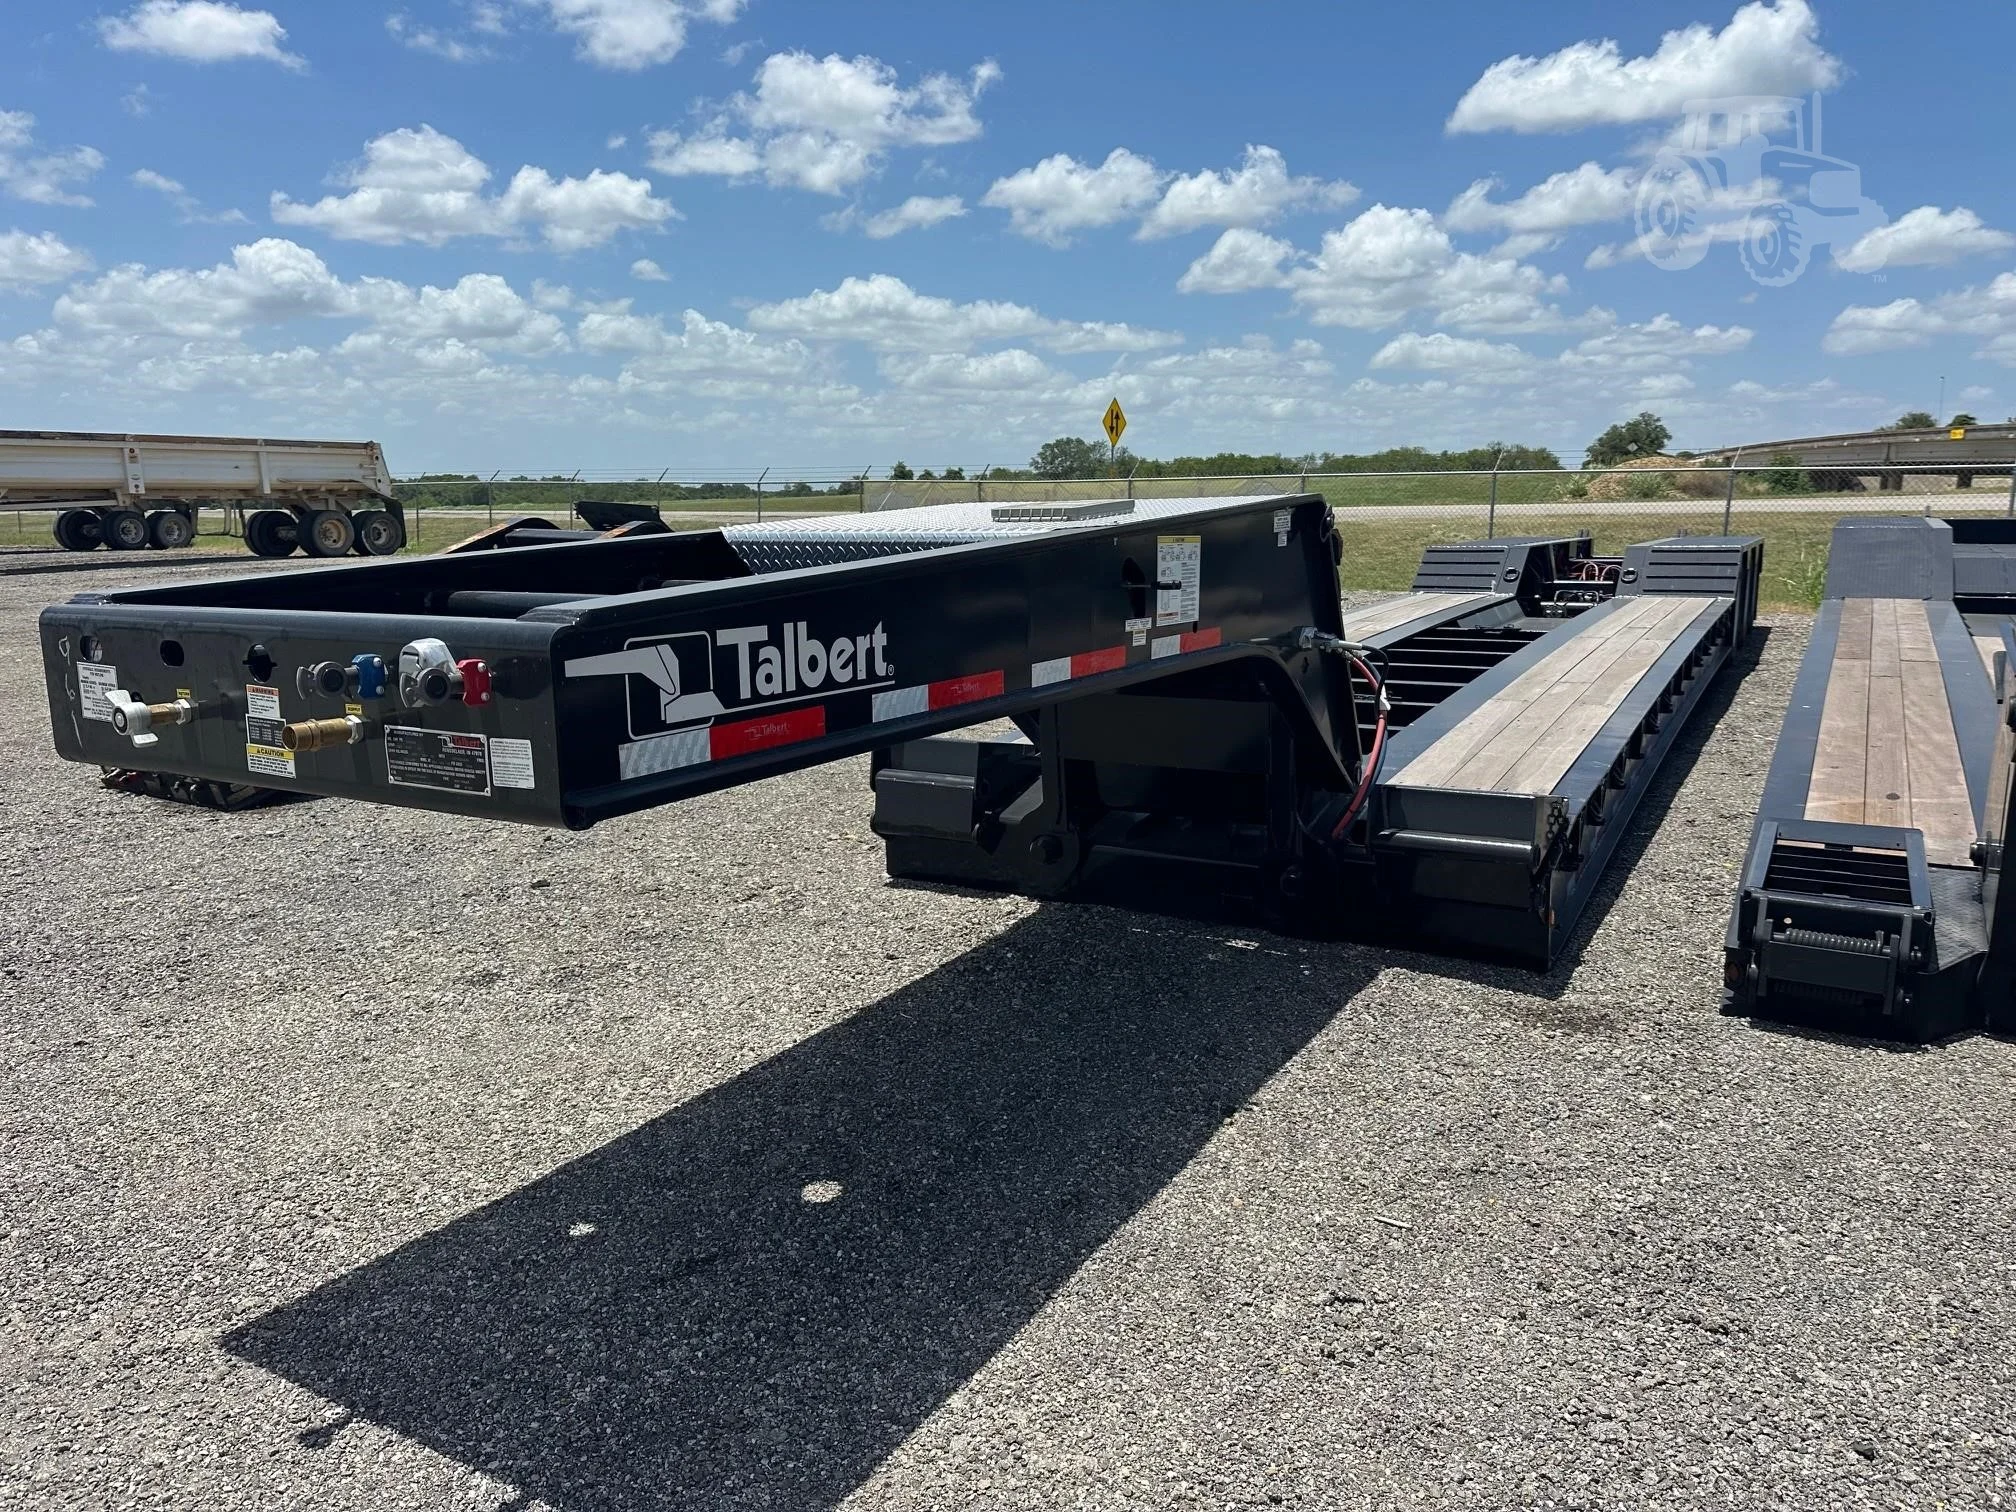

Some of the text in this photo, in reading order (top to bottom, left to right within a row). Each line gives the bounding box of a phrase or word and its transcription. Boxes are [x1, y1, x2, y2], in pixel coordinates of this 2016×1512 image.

[716, 620, 888, 700] Talbert
[761, 722, 789, 736] Talbert
[260, 748, 285, 758] CAUTION
